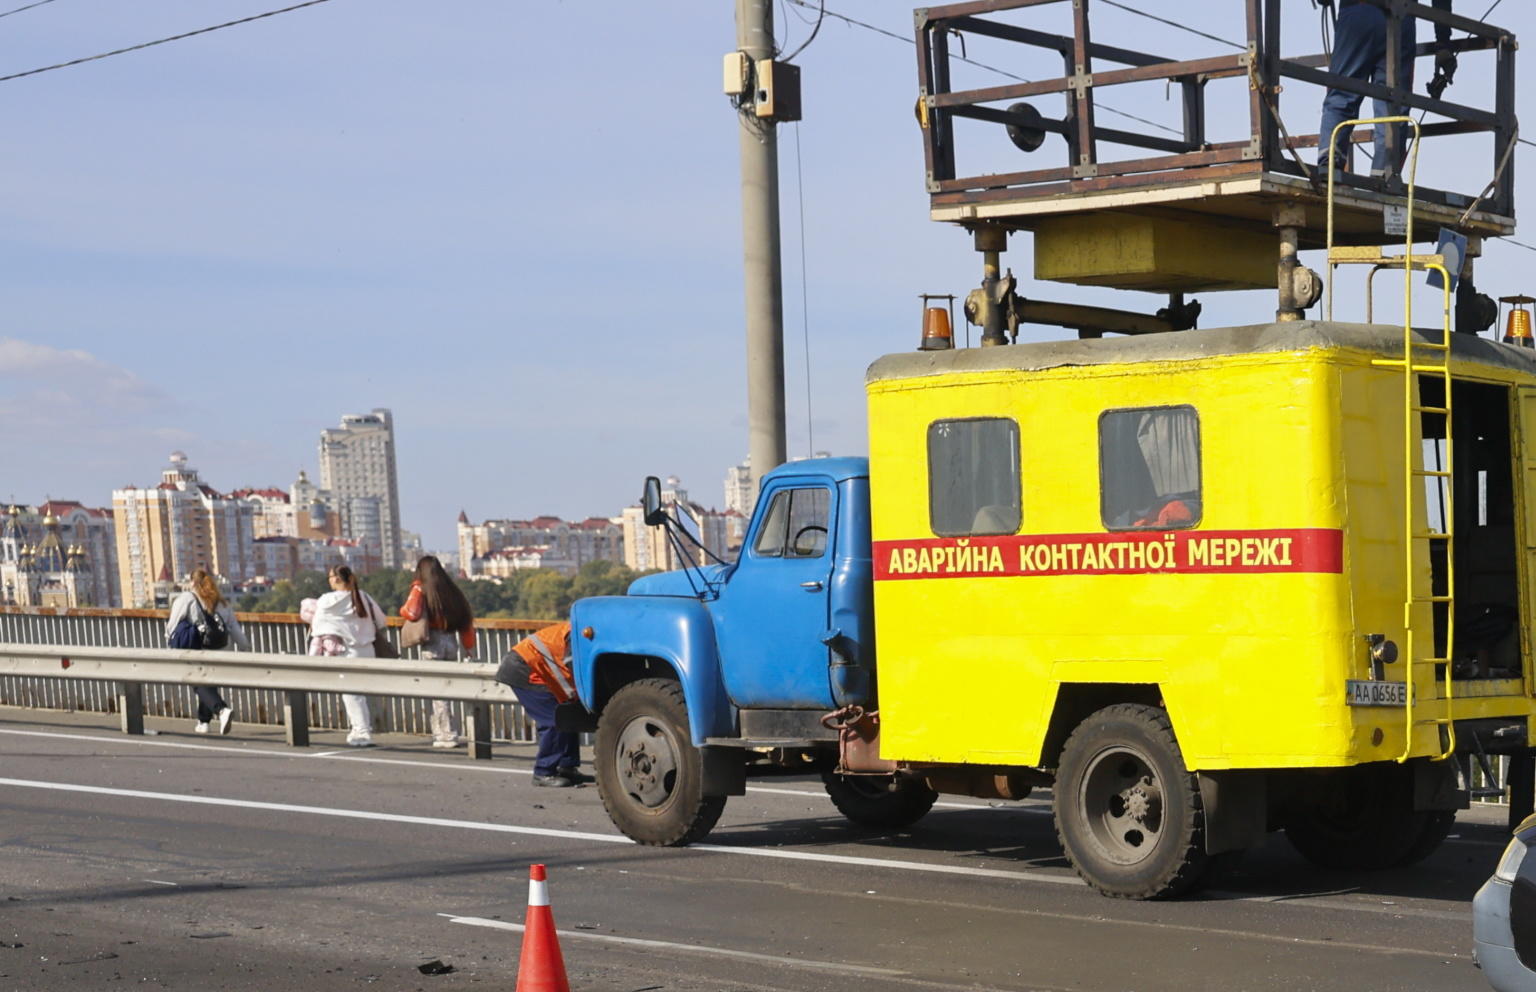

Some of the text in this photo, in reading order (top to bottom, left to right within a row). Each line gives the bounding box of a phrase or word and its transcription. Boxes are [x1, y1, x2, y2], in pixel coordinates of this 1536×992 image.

[889, 534, 1292, 573] АВАРІЙНА КОНТАКТНОЇ МЕРЕЖІ
